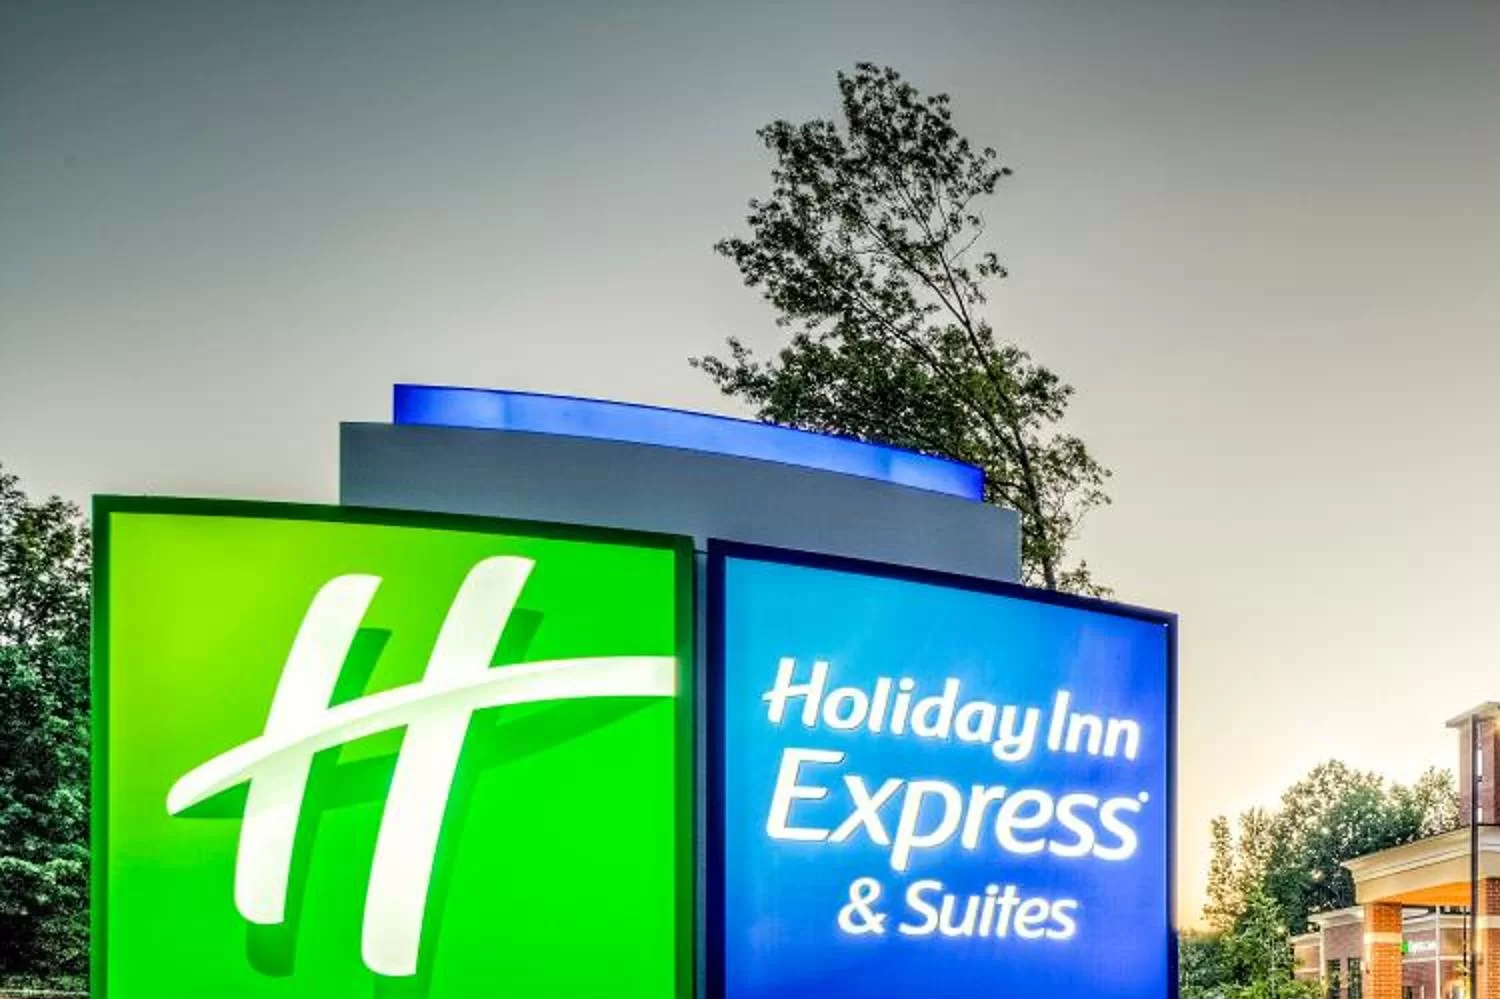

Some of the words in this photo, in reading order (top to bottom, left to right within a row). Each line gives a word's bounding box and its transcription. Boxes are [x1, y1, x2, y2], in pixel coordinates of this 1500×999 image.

[166, 555, 677, 977] H
[762, 657, 1040, 763] Holiday
[1047, 690, 1141, 761] Inn
[766, 747, 1143, 872] Express
[837, 877, 888, 935] &
[898, 880, 1079, 940] Suites
